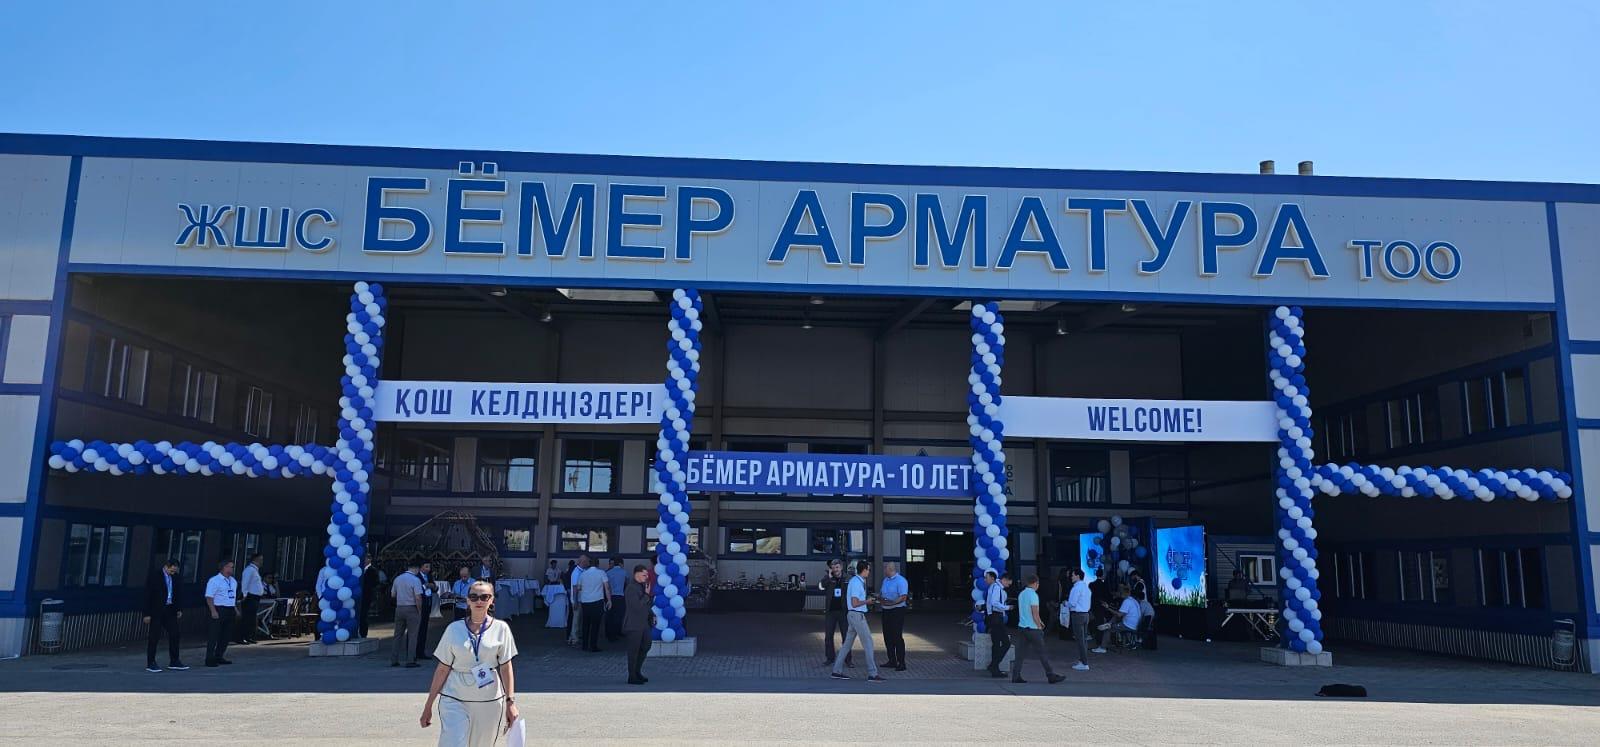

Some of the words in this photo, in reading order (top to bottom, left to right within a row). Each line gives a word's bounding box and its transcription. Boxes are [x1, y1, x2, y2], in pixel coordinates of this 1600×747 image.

[175, 203, 337, 252] ЖШС
[362, 161, 736, 262] БЁМЕР
[767, 189, 1331, 279] АРМАТУРА
[1347, 239, 1462, 281] ТОО
[396, 388, 453, 418] ҚОШ
[470, 389, 653, 419] КЕЛДІҢІЗДЕР!
[1087, 405, 1203, 433] WELCOME!
[686, 454, 763, 485] БЁМЕР
